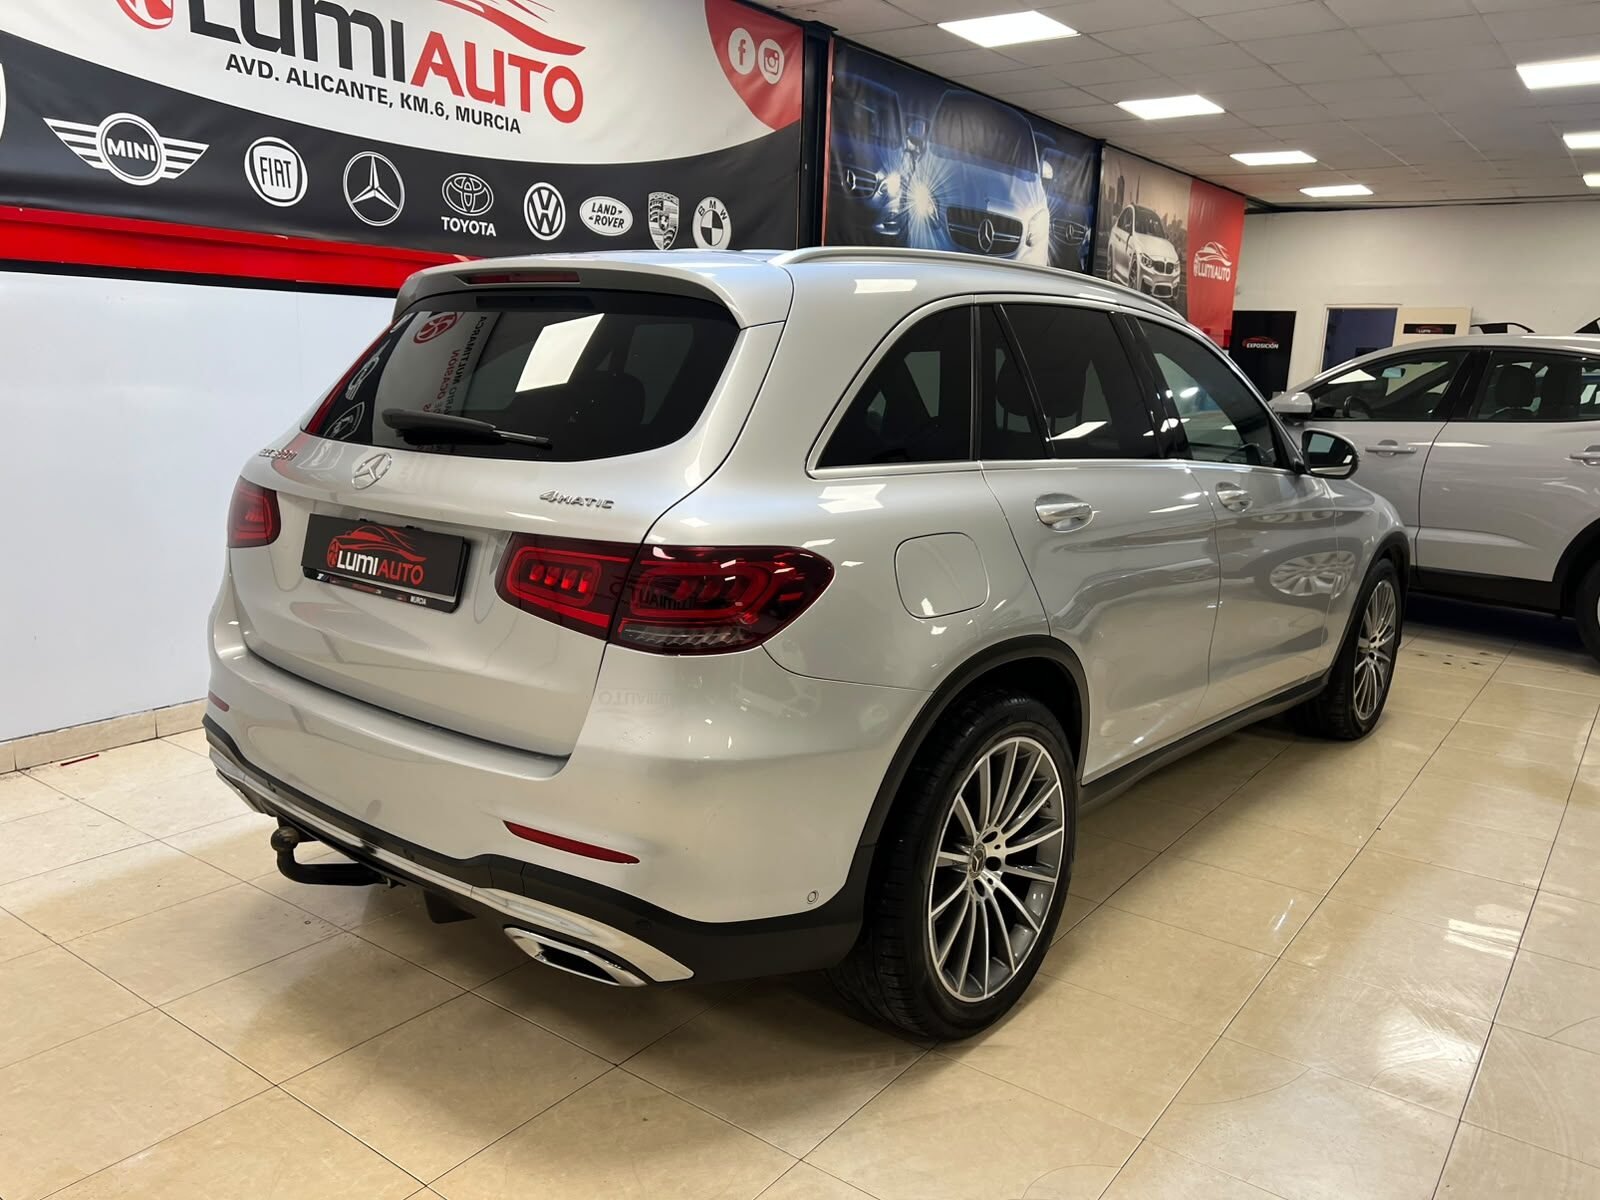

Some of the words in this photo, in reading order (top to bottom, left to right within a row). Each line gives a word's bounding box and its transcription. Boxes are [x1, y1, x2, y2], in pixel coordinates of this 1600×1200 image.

[225, 53, 281, 82] AVD.
[285, 67, 395, 109] ALICANTE,
[400, 92, 450, 121] KM.6,
[455, 107, 522, 134] MURCIA
[106, 137, 157, 163] MINI
[259, 156, 293, 190] FIAT
[440, 216, 497, 238] TOYOTA
